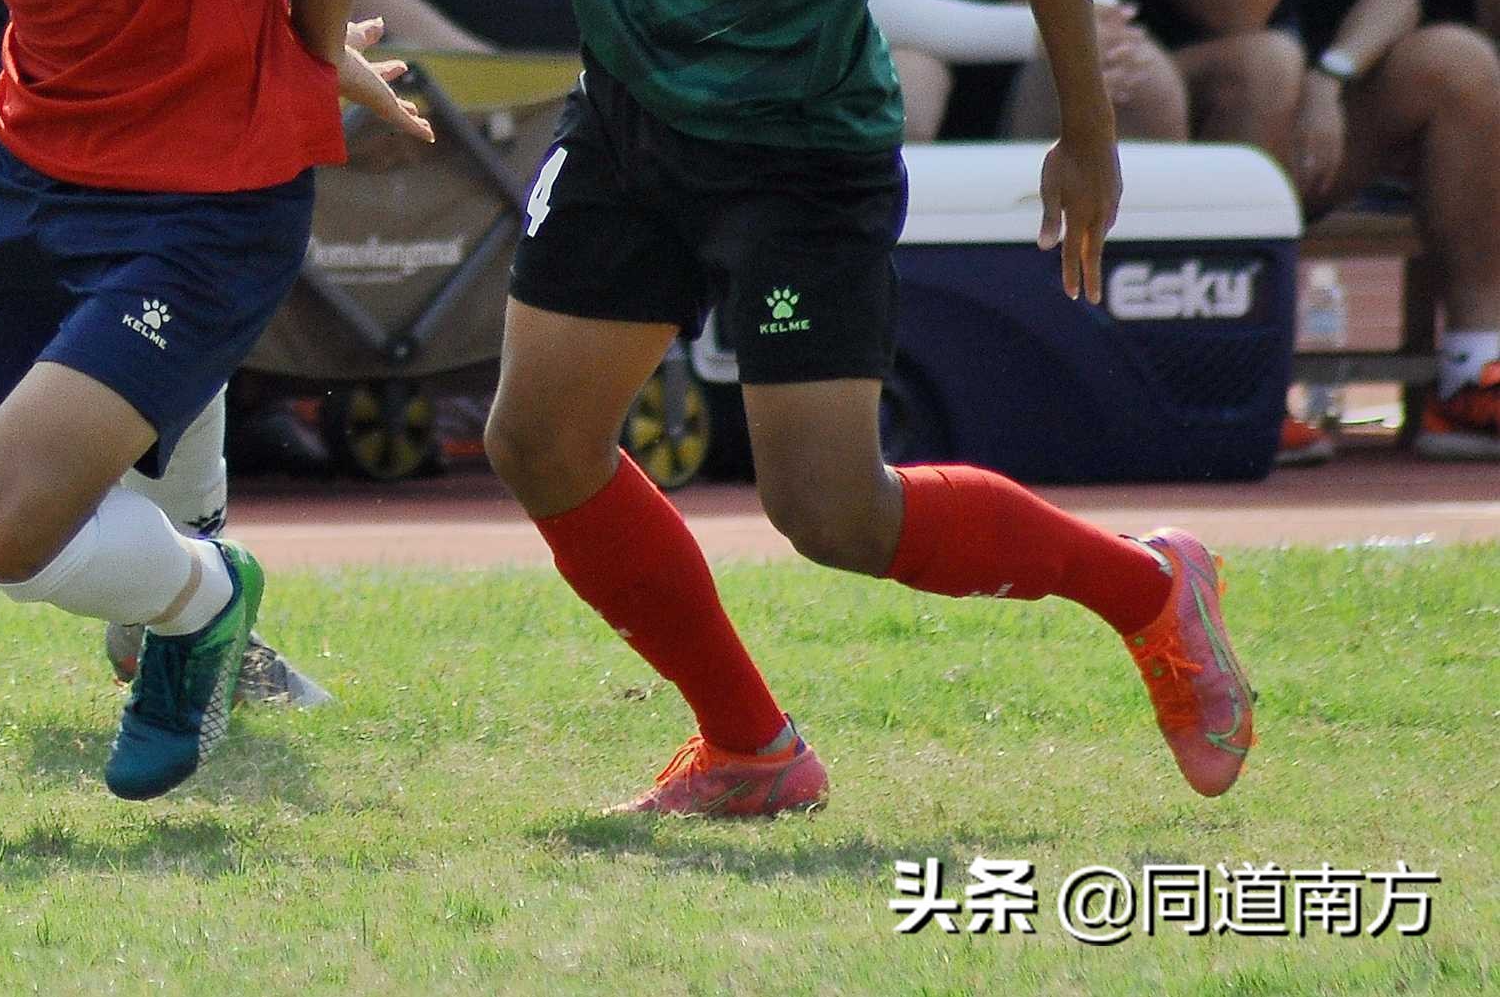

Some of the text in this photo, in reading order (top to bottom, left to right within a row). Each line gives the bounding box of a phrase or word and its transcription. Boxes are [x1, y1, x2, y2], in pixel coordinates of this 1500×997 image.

[1107, 261, 1257, 320] Esky
[122, 313, 168, 350] KELME
[759, 319, 810, 334] KELME
